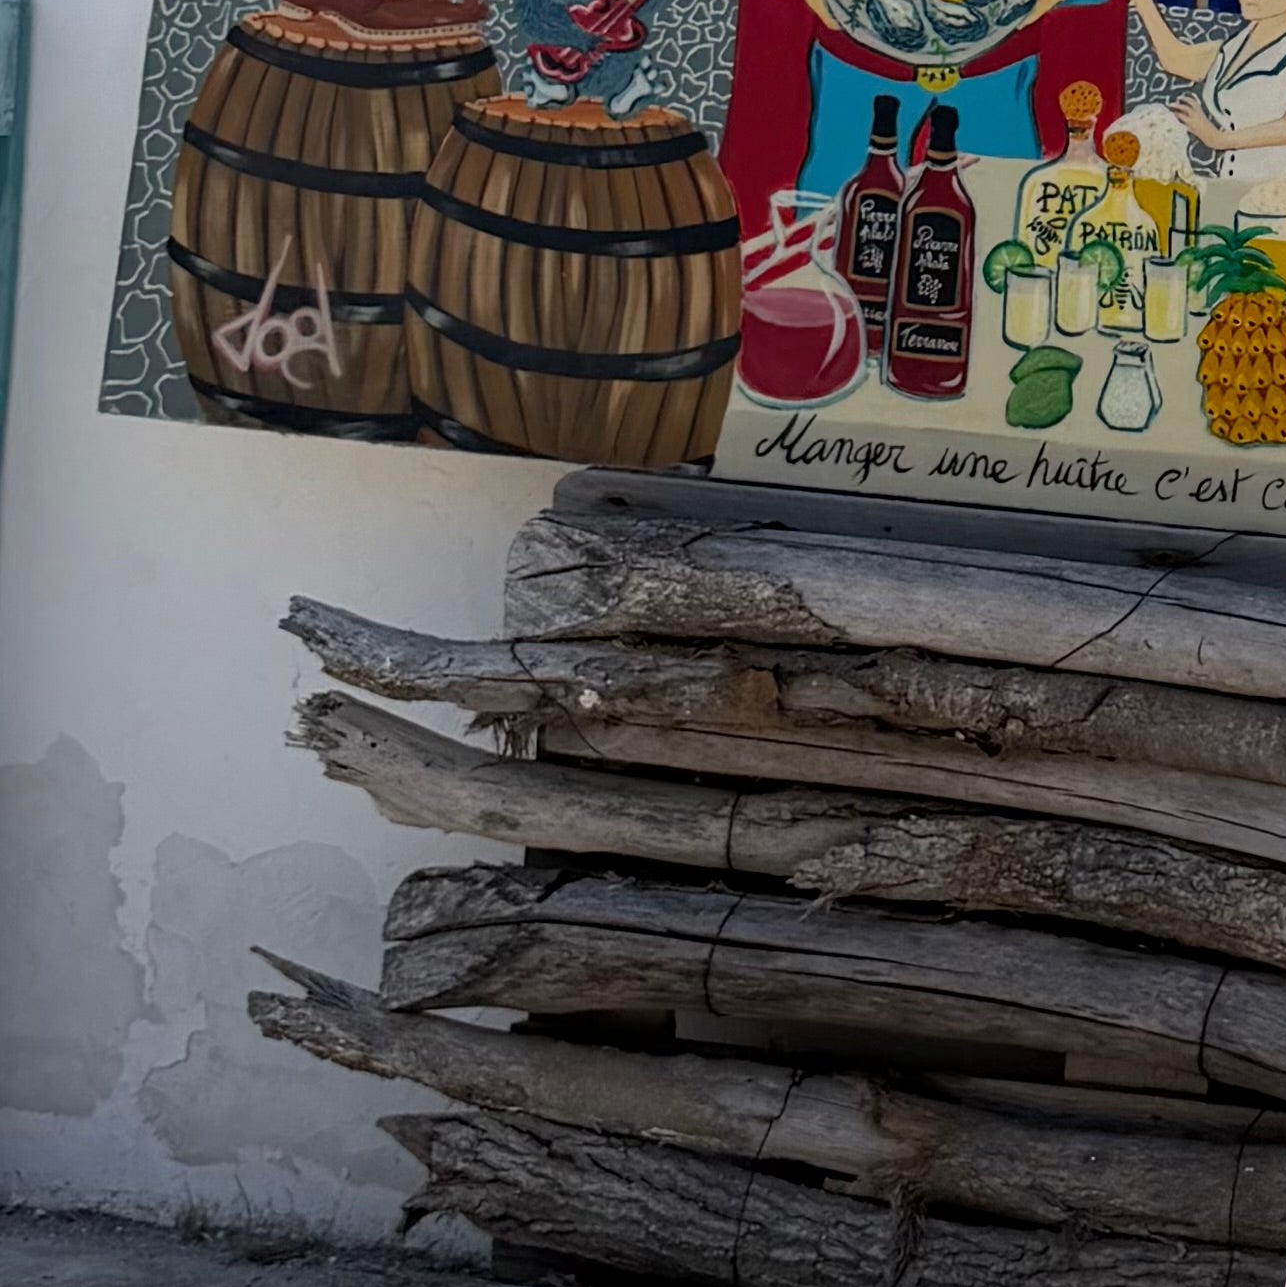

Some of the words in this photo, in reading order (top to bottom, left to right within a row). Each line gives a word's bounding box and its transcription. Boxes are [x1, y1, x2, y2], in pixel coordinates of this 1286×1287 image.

[1036, 182, 1099, 214] PAT
[755, 412, 912, 484] Manger
[928, 447, 1023, 484] une
